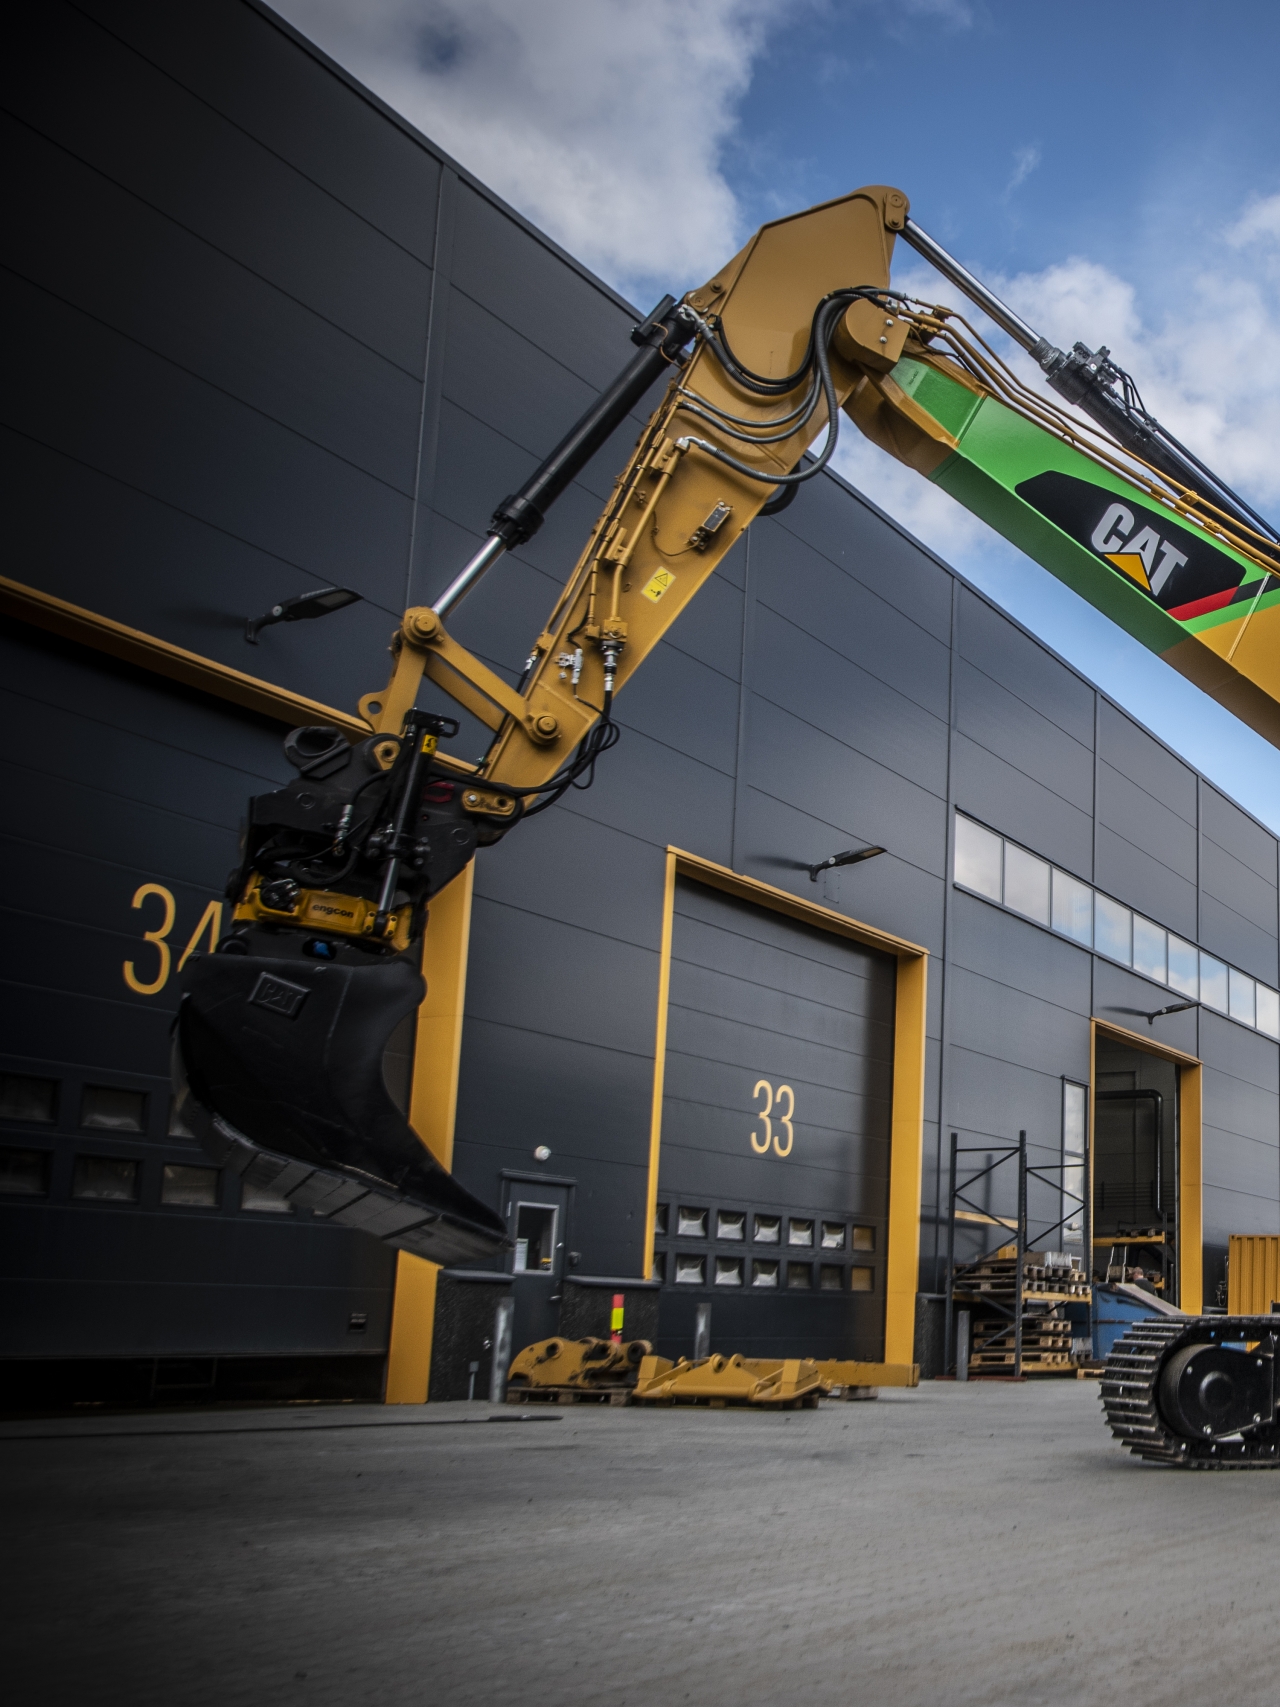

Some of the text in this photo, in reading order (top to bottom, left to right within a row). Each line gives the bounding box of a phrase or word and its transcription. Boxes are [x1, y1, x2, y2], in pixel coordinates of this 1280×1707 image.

[1091, 503, 1189, 596] CAT
[312, 904, 354, 918] engcon
[751, 1080, 795, 1156] 33
